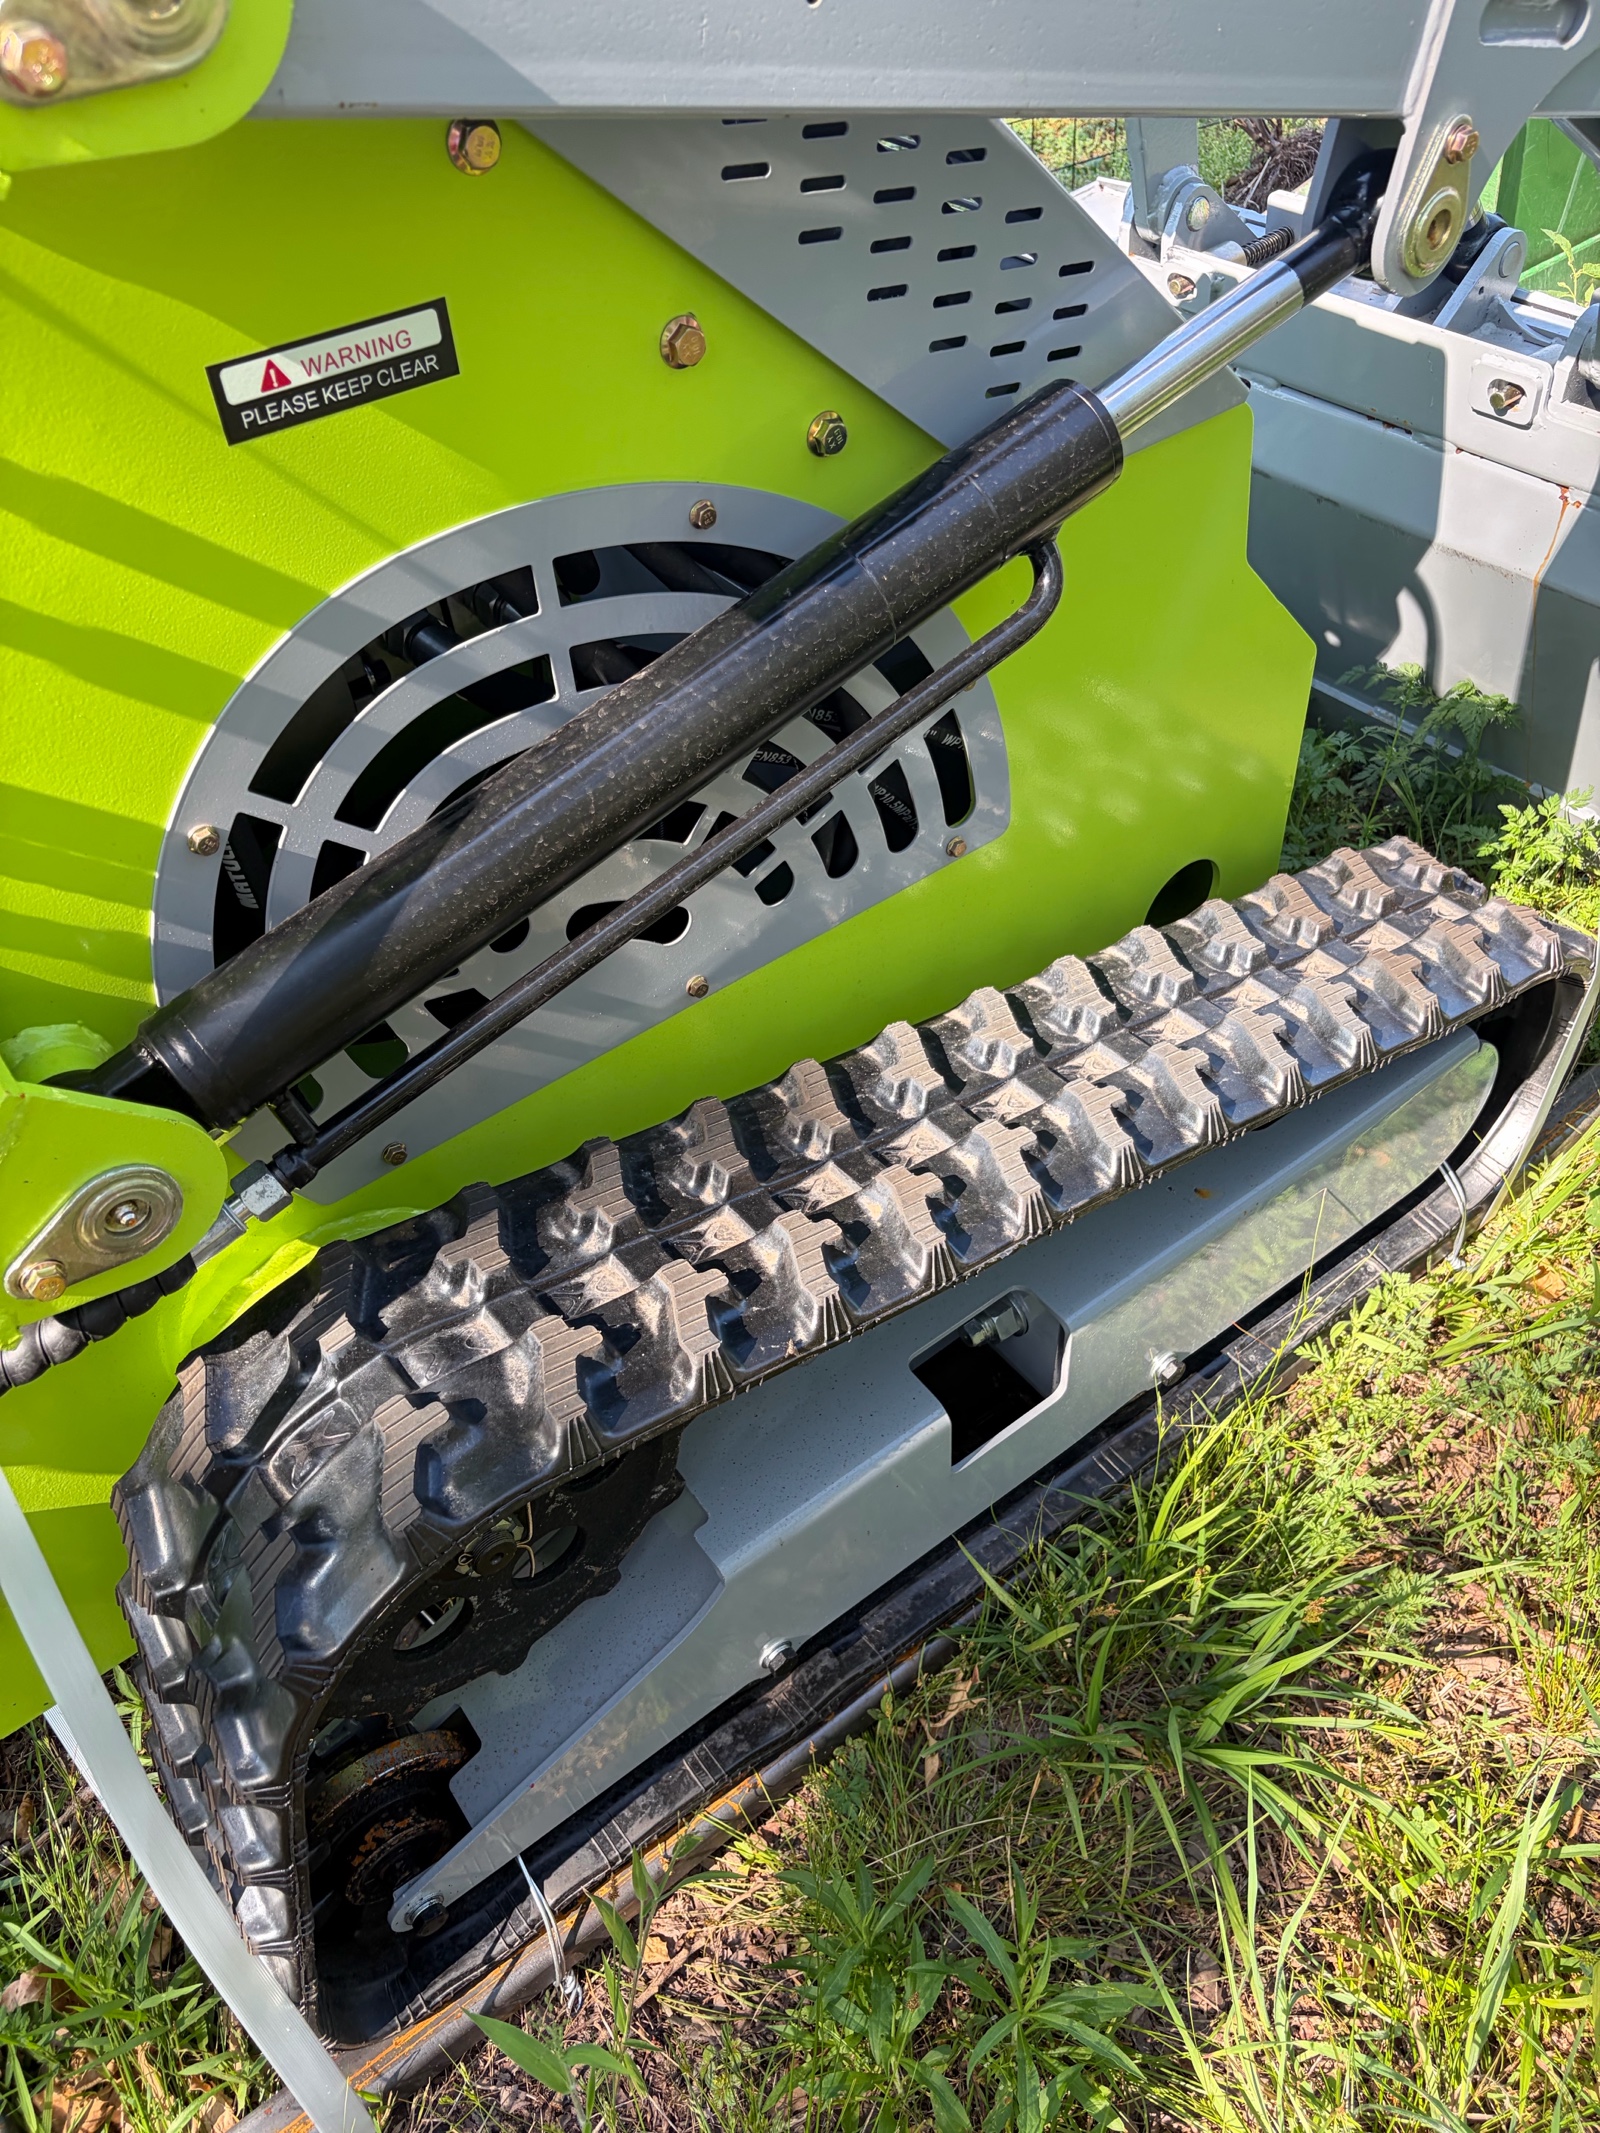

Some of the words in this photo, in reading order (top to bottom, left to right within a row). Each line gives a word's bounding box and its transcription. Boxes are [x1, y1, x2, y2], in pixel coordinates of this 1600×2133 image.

[300, 329, 412, 378] WARNING
[240, 390, 320, 430] PLEASE
[322, 374, 372, 405] KEEP
[376, 353, 440, 388] CLEAR
